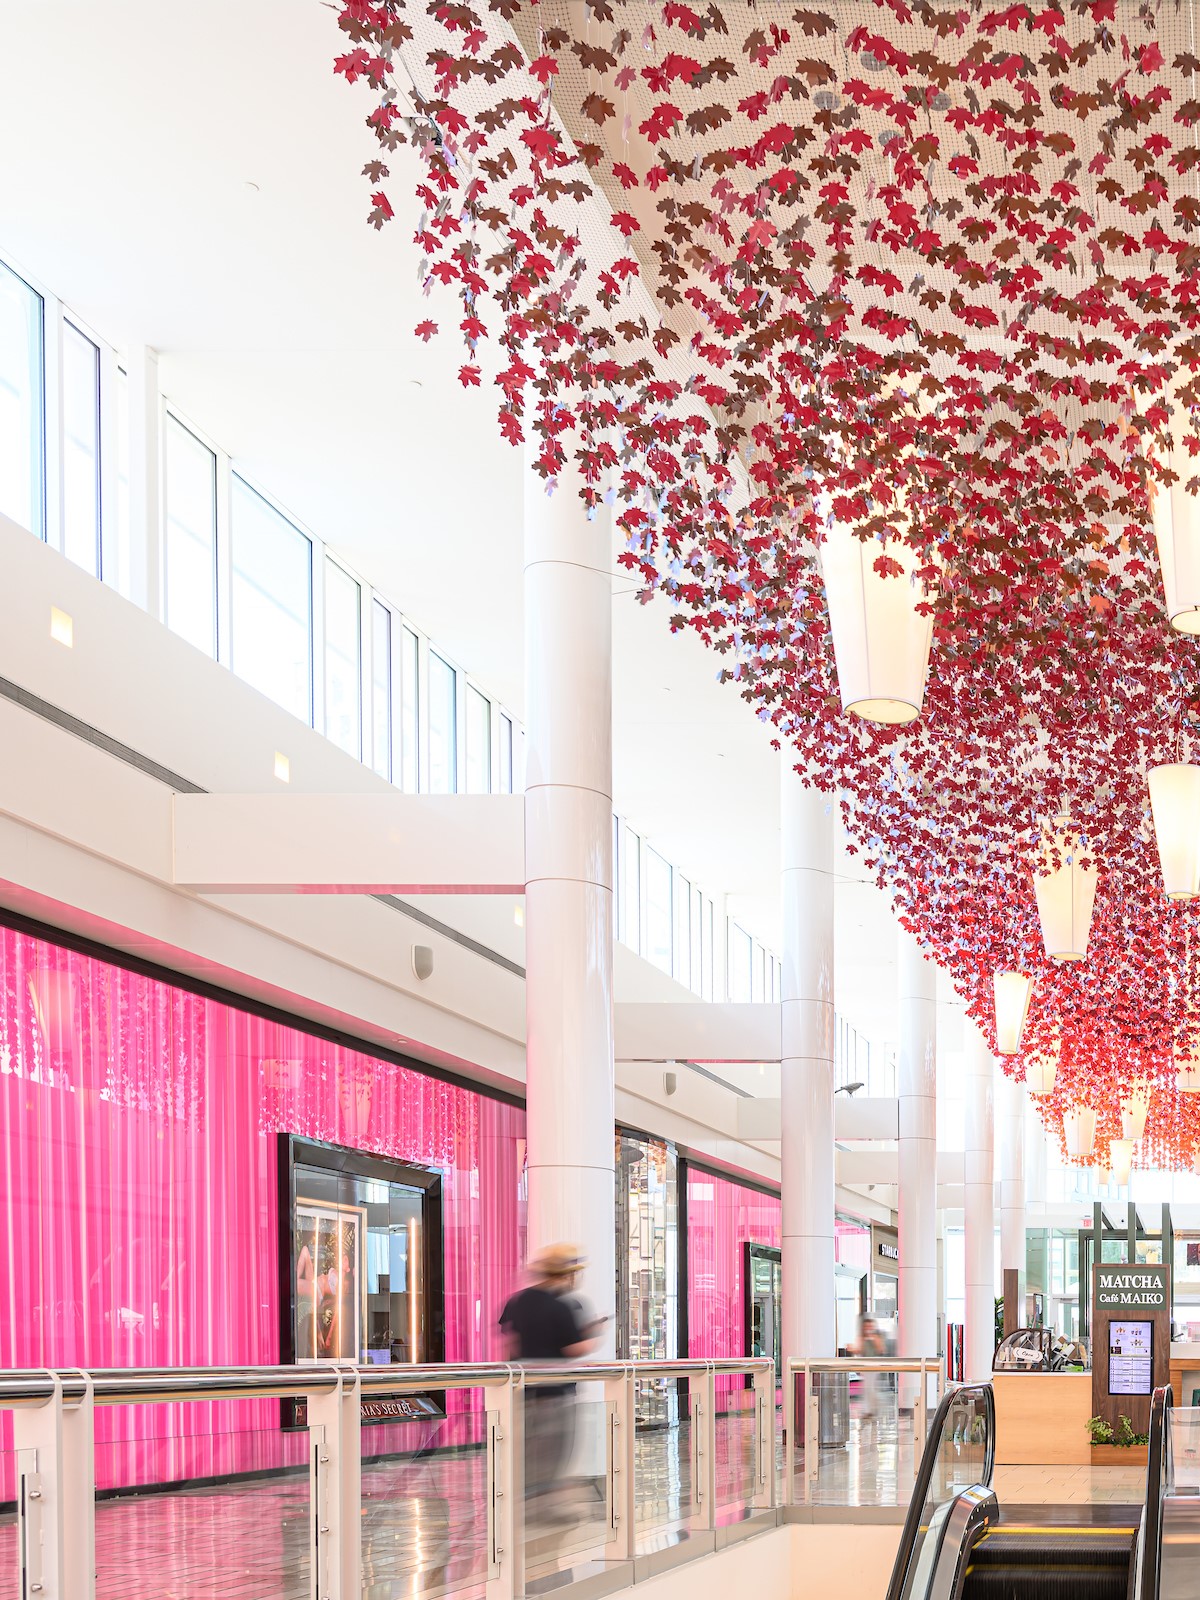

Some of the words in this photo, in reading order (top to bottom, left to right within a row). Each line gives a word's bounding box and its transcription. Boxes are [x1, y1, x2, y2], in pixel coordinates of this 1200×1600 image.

[1099, 1275, 1163, 1288] MATCHA
[1099, 1293, 1119, 1303] Café
[1120, 1292, 1163, 1304] MAIKO
